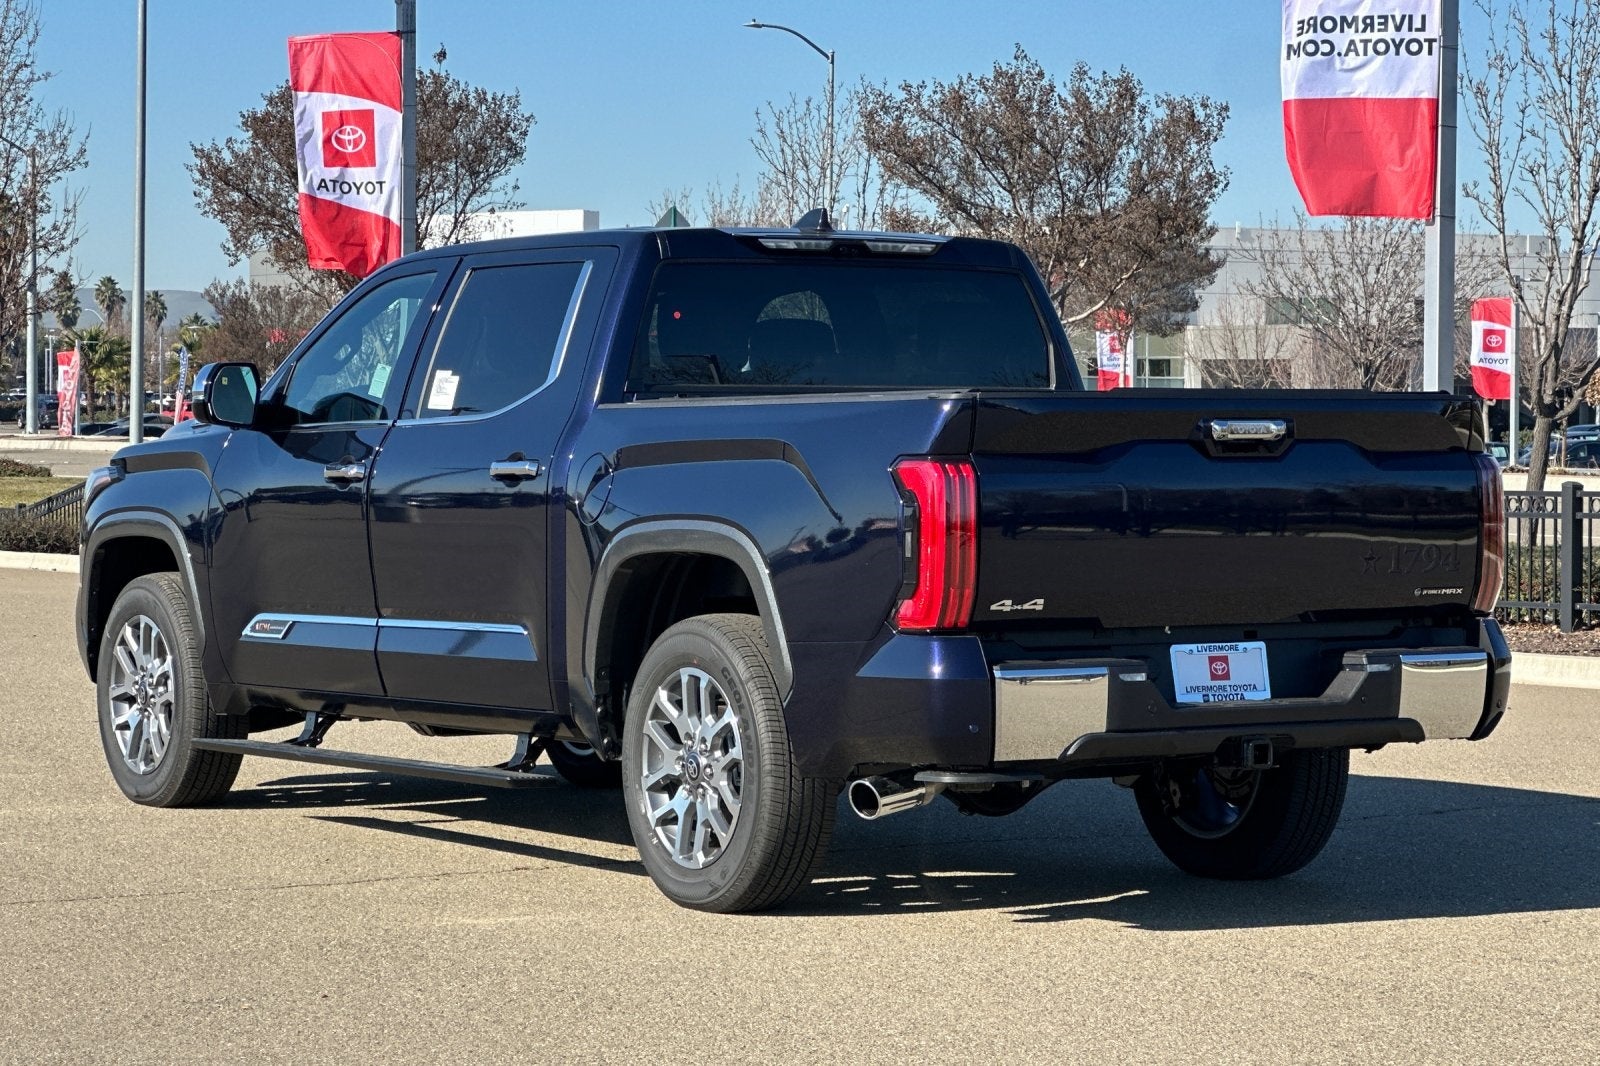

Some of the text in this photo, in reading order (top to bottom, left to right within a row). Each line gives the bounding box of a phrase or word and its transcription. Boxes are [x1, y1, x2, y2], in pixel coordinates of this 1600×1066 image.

[1388, 543, 1461, 574] 1794
[1196, 644, 1240, 653] LIVERMORE
[1185, 684, 1258, 693] LIVERMORE TOYOTA
[1211, 692, 1246, 701] TOYOTA
